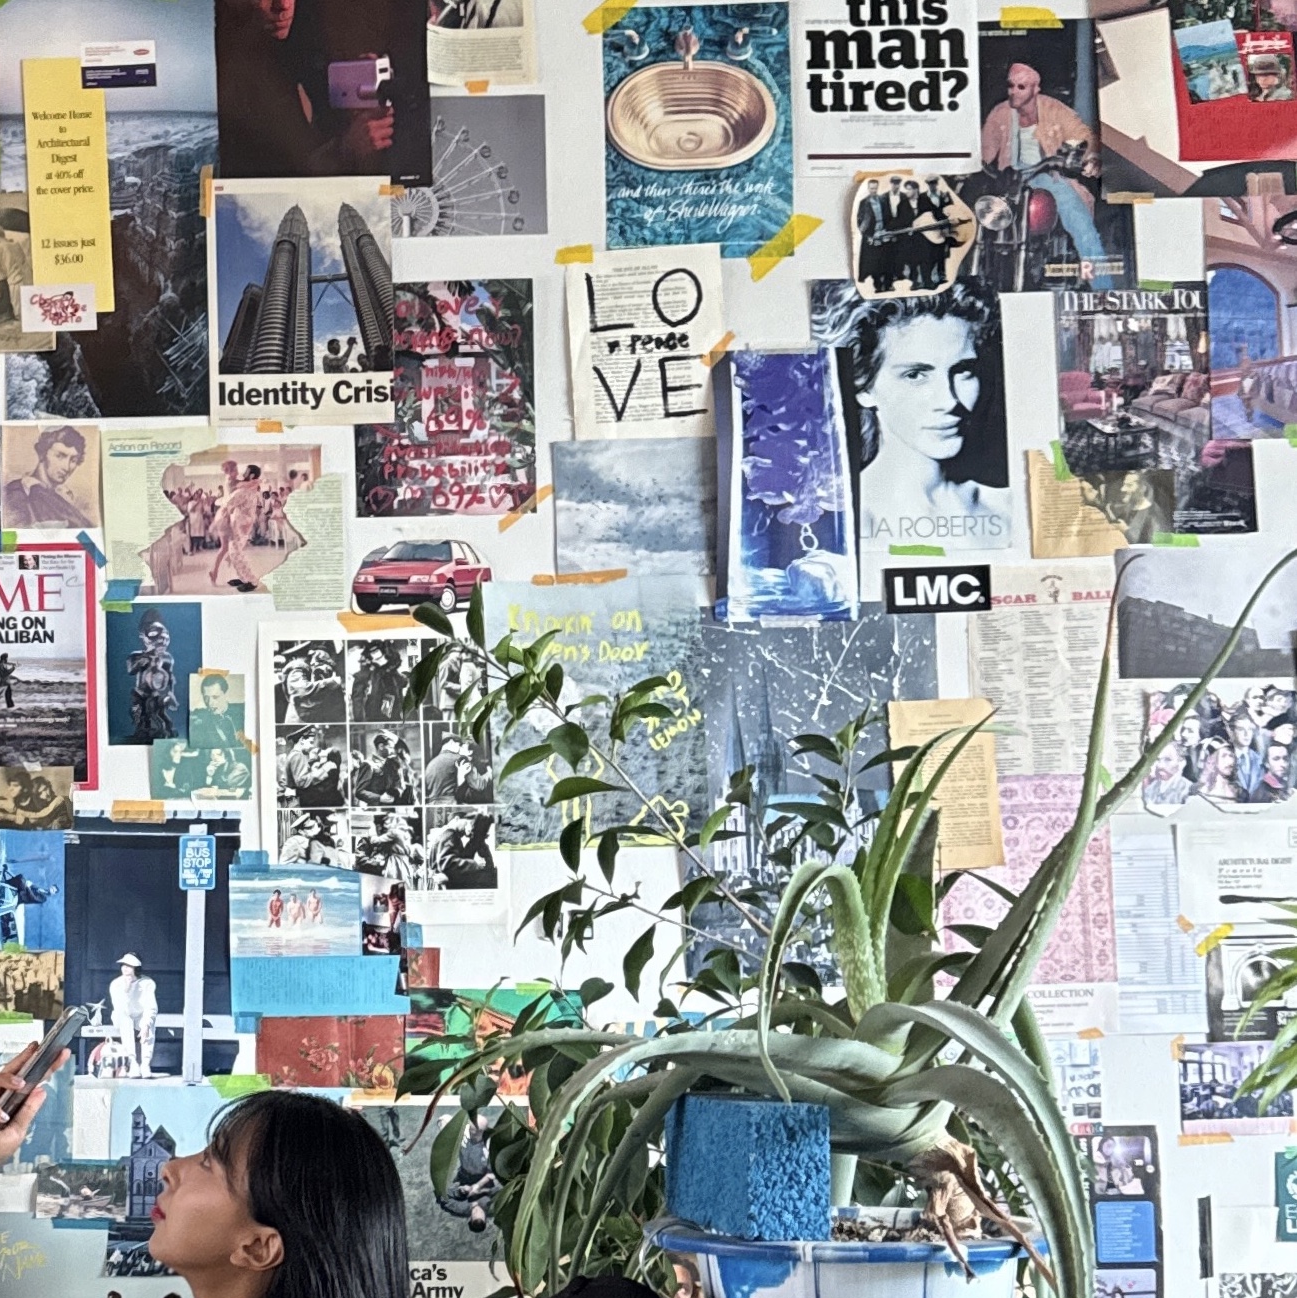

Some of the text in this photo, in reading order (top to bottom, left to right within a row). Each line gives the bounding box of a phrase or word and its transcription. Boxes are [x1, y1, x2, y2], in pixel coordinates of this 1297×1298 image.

[806, 27, 968, 71] man
[808, 68, 968, 114] tired?
[32, 110, 92, 120] Welcome Home
[36, 136, 90, 148] Architectural
[51, 154, 77, 165] Digest
[54, 170, 72, 179] 40%
[73, 168, 84, 179] off
[36, 186, 48, 195] the
[50, 186, 71, 194] cover
[41, 238, 96, 249] 12 issues just
[54, 253, 83, 265] $36.00
[1063, 291, 1103, 312] THE
[1107, 289, 1169, 311] STARK
[218, 382, 325, 410] Identity
[108, 440, 182, 451] Action on Record
[899, 515, 1002, 540] ROBERTS
[21, 617, 46, 630] ON
[611, 609, 643, 632] on
[599, 640, 649, 663] Door
[647, 708, 702, 751] LEMON
[185, 847, 211, 858] BUS
[183, 857, 212, 868] STOP
[1027, 988, 1094, 998] COLLECTION
[409, 1263, 448, 1281] ca's
